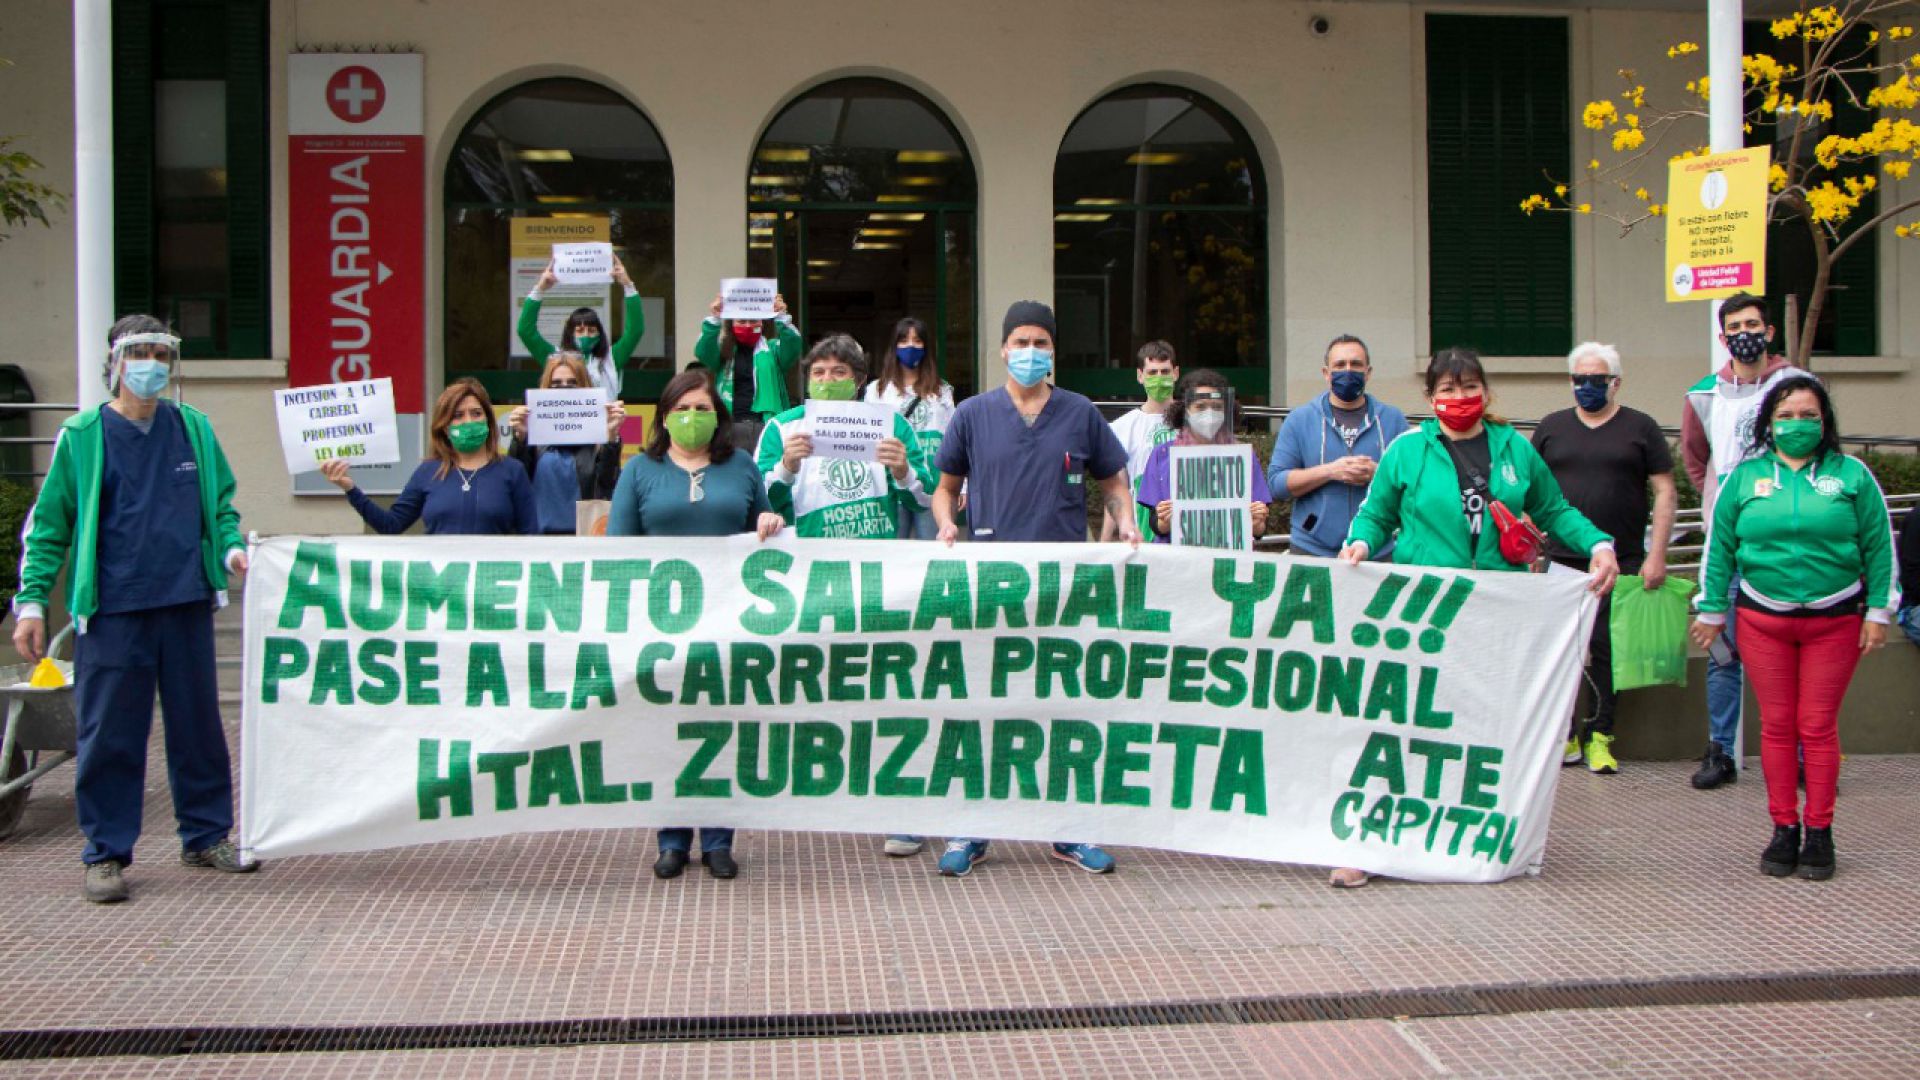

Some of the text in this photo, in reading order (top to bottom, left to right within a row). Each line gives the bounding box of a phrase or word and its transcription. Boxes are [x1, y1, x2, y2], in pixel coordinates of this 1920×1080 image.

[526, 225, 595, 234] BIENVENIDO
[330, 155, 371, 383] GUARDIA
[347, 386, 355, 398] A
[362, 383, 376, 397] LA
[309, 403, 360, 420] CARRERA
[536, 400, 583, 408] PERSONAL
[536, 410, 599, 419] SALUD SOMOS
[816, 416, 884, 427] PERSONAL DE
[303, 422, 376, 443] PROFESIONAL
[553, 423, 583, 432] TODOS
[815, 430, 884, 440] SALUD SOMOS
[314, 443, 367, 461] LEY 6035
[832, 443, 866, 452] TODOS
[1176, 454, 1246, 500] AUMENTO
[823, 502, 887, 525] HOSPITL
[1180, 507, 1245, 551] SALARIAL YA
[278, 541, 704, 634] AUMENTO
[739, 548, 1171, 635] SALARIAL
[261, 636, 1454, 730] PASE A LA CARRERA PROFESIONAL
[674, 716, 1267, 817] ZUBIZARRETA
[1348, 731, 1504, 809] ATE
[1331, 791, 1519, 865] CAPITAL
